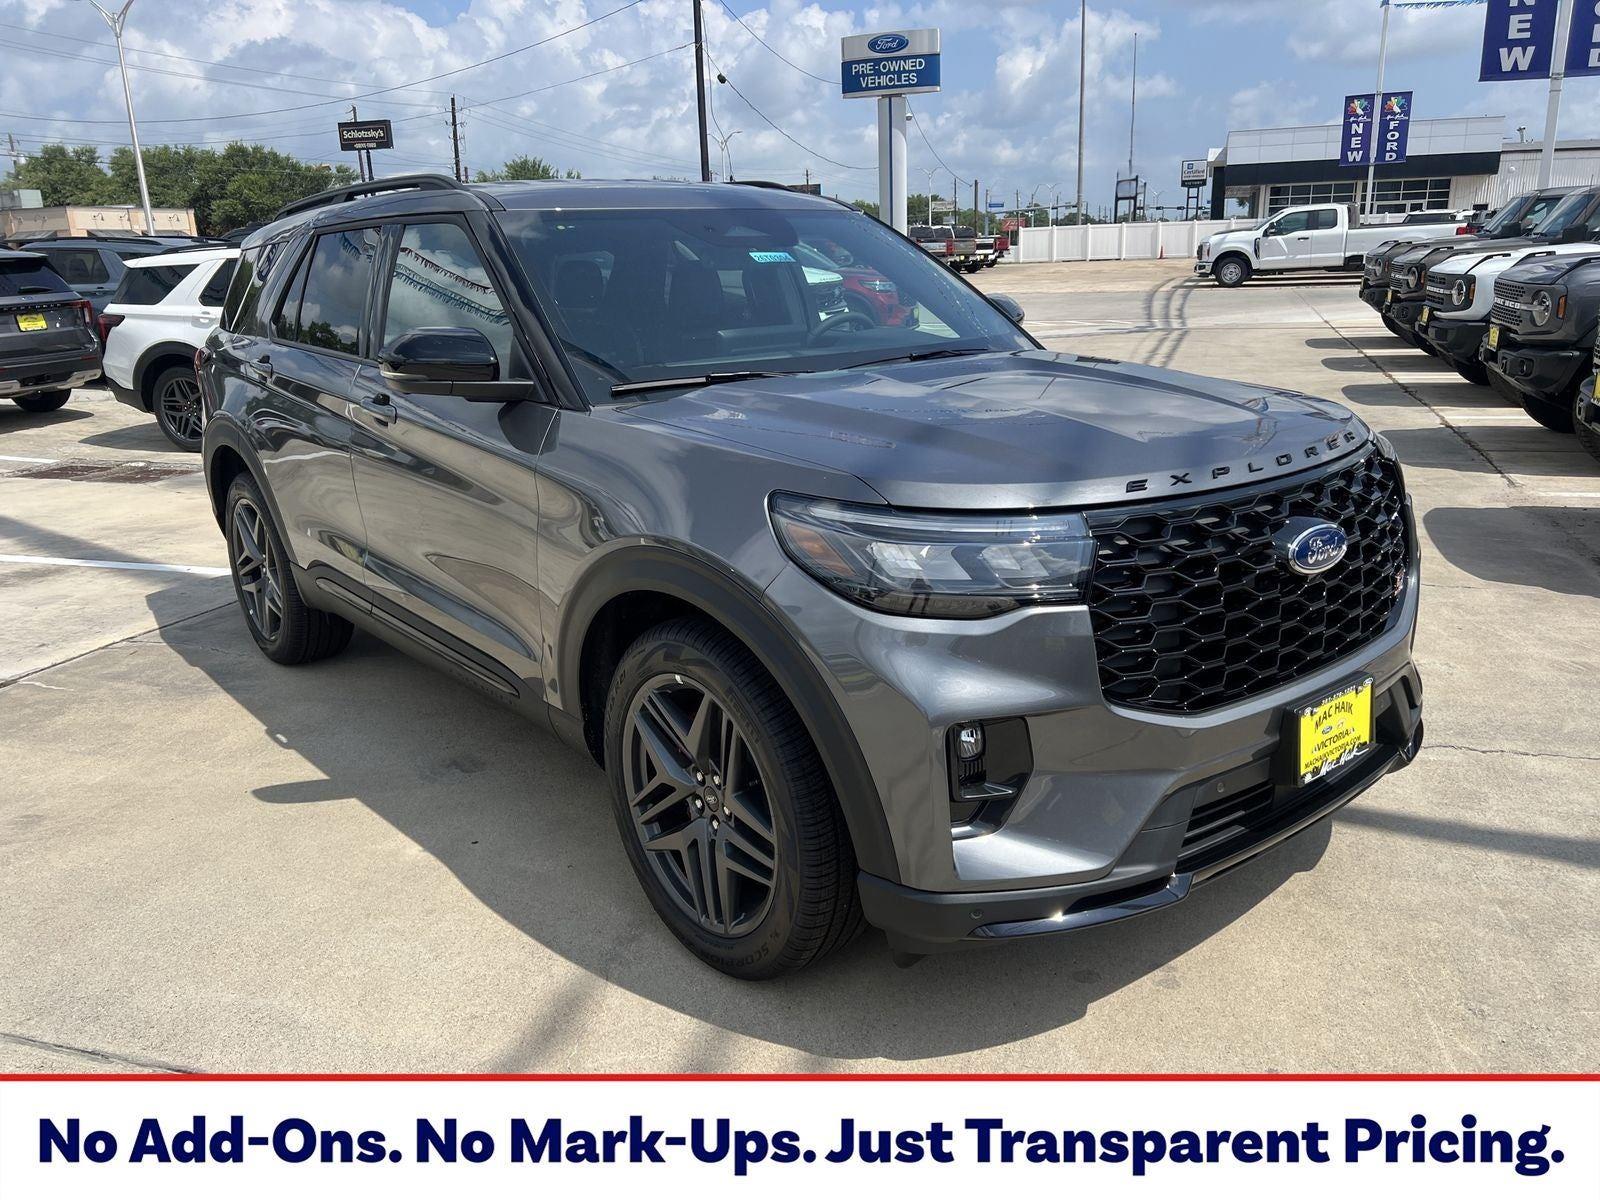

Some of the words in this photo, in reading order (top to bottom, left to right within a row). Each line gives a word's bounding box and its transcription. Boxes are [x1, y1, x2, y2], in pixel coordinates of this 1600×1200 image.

[875, 37, 899, 50] Ford
[1499, 0, 1536, 72] EW
[860, 73, 918, 88] VEHICLES
[343, 129, 384, 139] Schlotzsky's
[1347, 122, 1364, 162] NEW
[1384, 120, 1400, 162] FORD
[1125, 431, 1356, 494] EXPLORER
[1307, 536, 1342, 565] Ford
[1314, 704, 1333, 733] MAC
[1334, 700, 1353, 715] HAIK
[1316, 728, 1349, 751] VICTORIA
